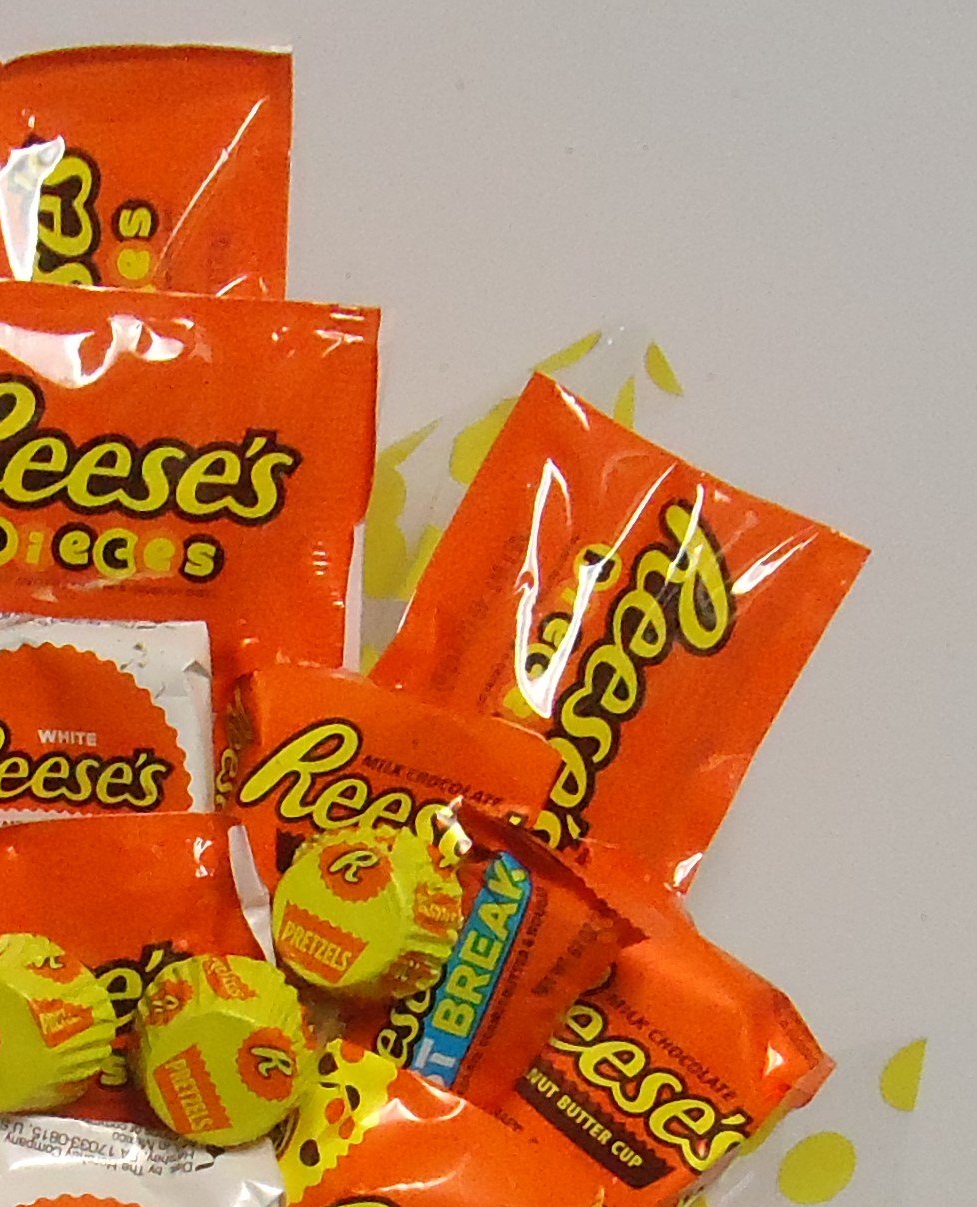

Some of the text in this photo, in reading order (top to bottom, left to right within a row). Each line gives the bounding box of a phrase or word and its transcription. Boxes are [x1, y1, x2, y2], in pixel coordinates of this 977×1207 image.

[37, 728, 98, 747] WHITE
[280, 919, 354, 973] PRETZELS
[431, 857, 528, 1038] BREAK
[165, 1057, 216, 1132] PRETZELS
[556, 1094, 613, 1146] BUTTER
[610, 1140, 643, 1168] CUP
